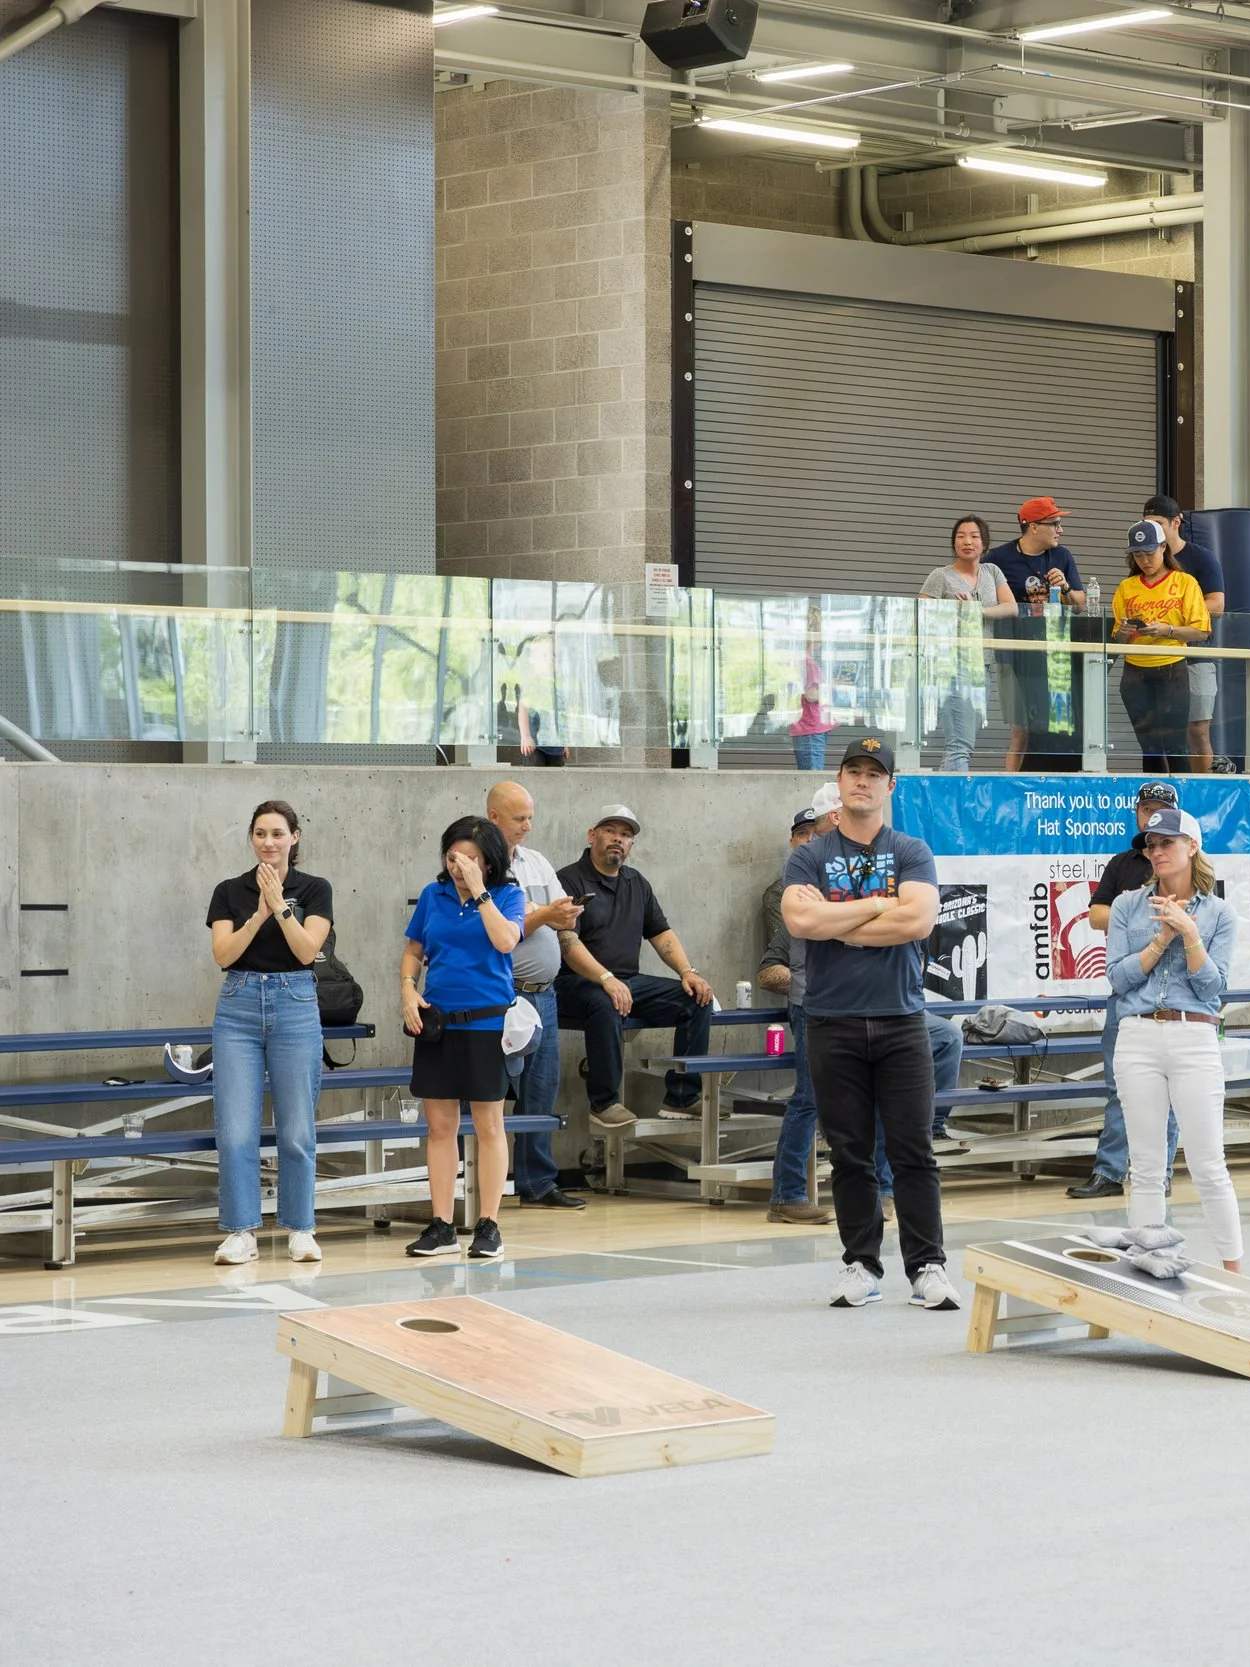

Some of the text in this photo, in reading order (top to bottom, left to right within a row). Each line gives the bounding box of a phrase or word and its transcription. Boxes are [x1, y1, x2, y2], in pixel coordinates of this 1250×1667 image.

[1024, 791, 1137, 812] Thank you to our
[1037, 818, 1126, 839] Hat Sponsors
[1049, 859, 1107, 880] steel, in
[957, 903, 986, 919] CLASSIC
[1029, 883, 1050, 980] amfab
